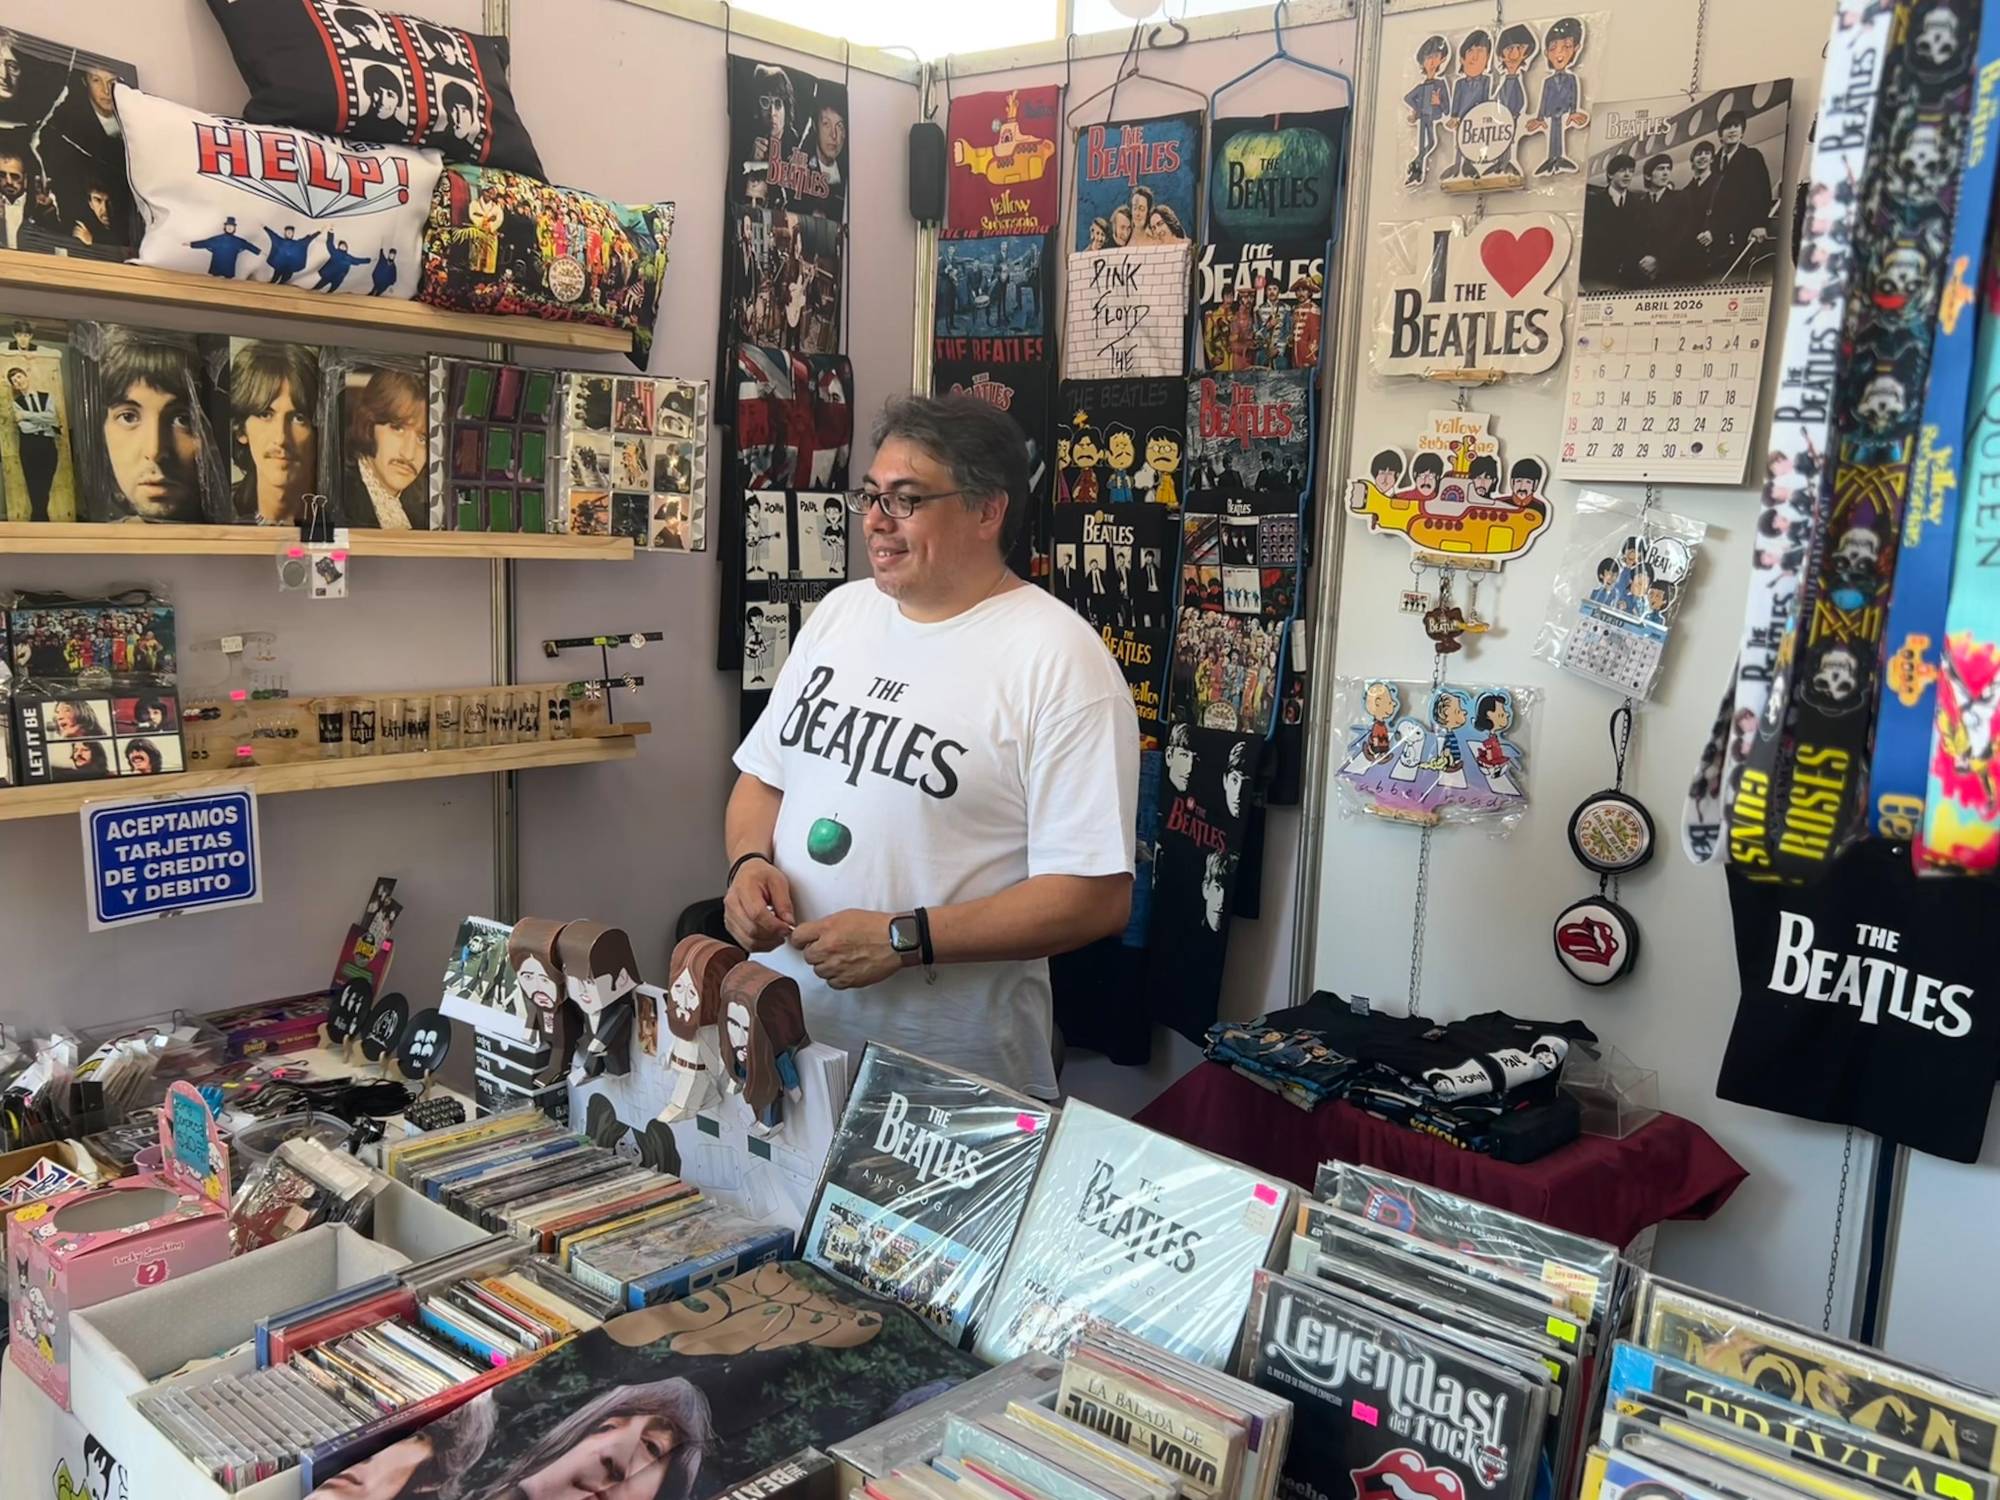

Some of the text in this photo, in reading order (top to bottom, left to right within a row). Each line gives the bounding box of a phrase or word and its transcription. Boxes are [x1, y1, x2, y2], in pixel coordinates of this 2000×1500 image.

[1462, 117, 1515, 153] BEATLES
[1605, 112, 1673, 142] BEATLES
[192, 121, 410, 204] HELP!
[766, 137, 831, 200] BEATLES
[1087, 125, 1181, 186] THE BEATLES
[990, 189, 1031, 215] Yellow
[1227, 157, 1320, 218] THE BEATLES
[1089, 254, 1142, 292] PINK
[1427, 230, 1453, 303] I
[1092, 291, 1150, 337] FLOYD
[1635, 300, 1703, 312] ABRIL 2026
[1389, 283, 1549, 369] THE BEATLES
[1654, 335, 1739, 350] 1 2 3 4
[1098, 338, 1138, 373] THE
[1599, 365, 1605, 378] 6
[1624, 365, 1630, 378] 7
[1649, 364, 1655, 377] 8
[1675, 364, 1681, 377] 9
[1703, 363, 1713, 377] 10
[1730, 363, 1738, 376] 11
[1101, 383, 1169, 408] BEATLES
[1200, 377, 1294, 450] THE BEATLES
[1572, 391, 1736, 405] 12 13 14 15 16 17 18
[1435, 417, 1482, 434] Yellow
[1568, 417, 1733, 432] 19 20 21 22 23 24 25
[1563, 443, 1675, 458] 26 27 28 29 30
[799, 500, 818, 513] PAUL
[1082, 513, 1135, 548] BEATLES
[1102, 625, 1152, 666] BEATLES
[23, 707, 44, 777] LET IT BE
[779, 665, 969, 800] THE BEATLES
[1730, 767, 1770, 867] GUNS
[1778, 744, 1849, 861] ROSES
[106, 805, 238, 841] ACEPTAMOS
[1167, 797, 1228, 854] BEATLES
[115, 831, 232, 862] TARJETAS
[104, 850, 246, 887] DE CREDITO
[121, 873, 231, 905] Y DEBITO
[1767, 910, 1975, 1039] THE BEATLES
[927, 1105, 952, 1129] THE
[873, 1091, 984, 1190] BEATLES
[1077, 1158, 1202, 1274] BEATLES
[1088, 1378, 1204, 1449] LA BALADA DE
[1138, 1427, 1148, 1441] Y
[1387, 1410, 1493, 1488] del rock
